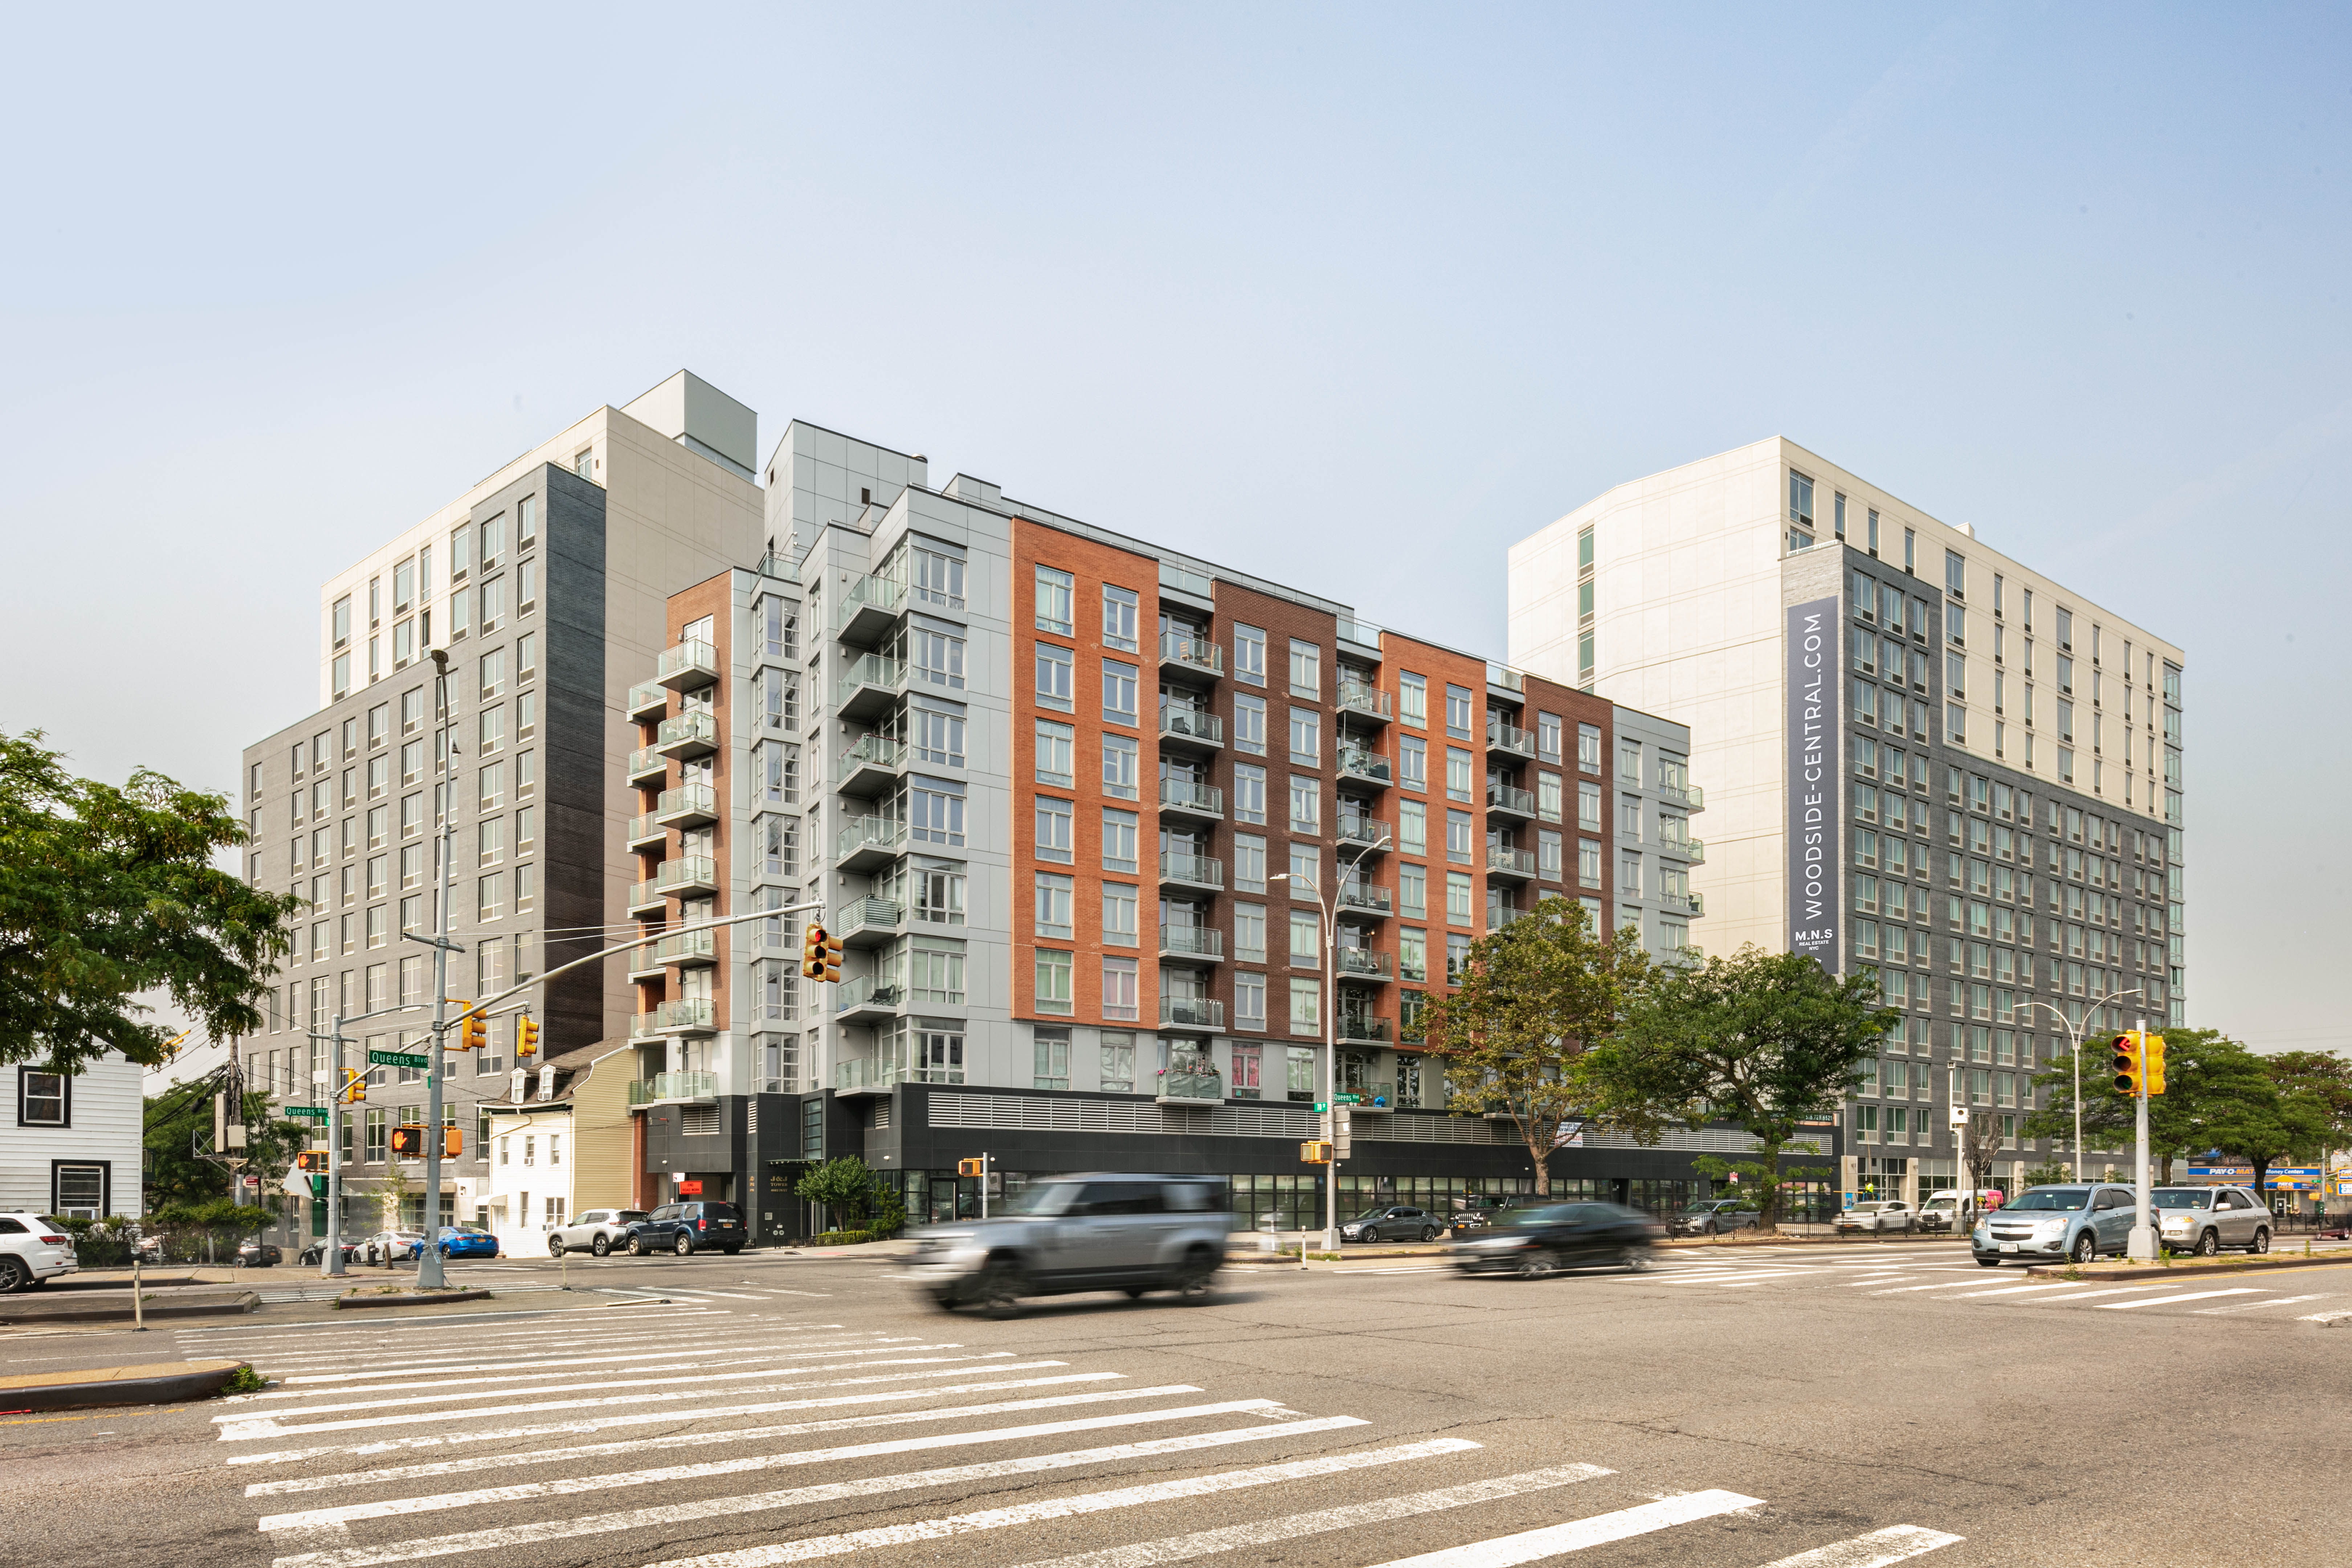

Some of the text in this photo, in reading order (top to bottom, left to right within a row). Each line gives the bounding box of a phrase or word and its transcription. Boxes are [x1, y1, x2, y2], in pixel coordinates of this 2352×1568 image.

[1804, 613, 1822, 920] WOODSIDE-CENTRAL.COM
[1795, 928, 1833, 941] M.N.S
[372, 1052, 410, 1065] Queens
